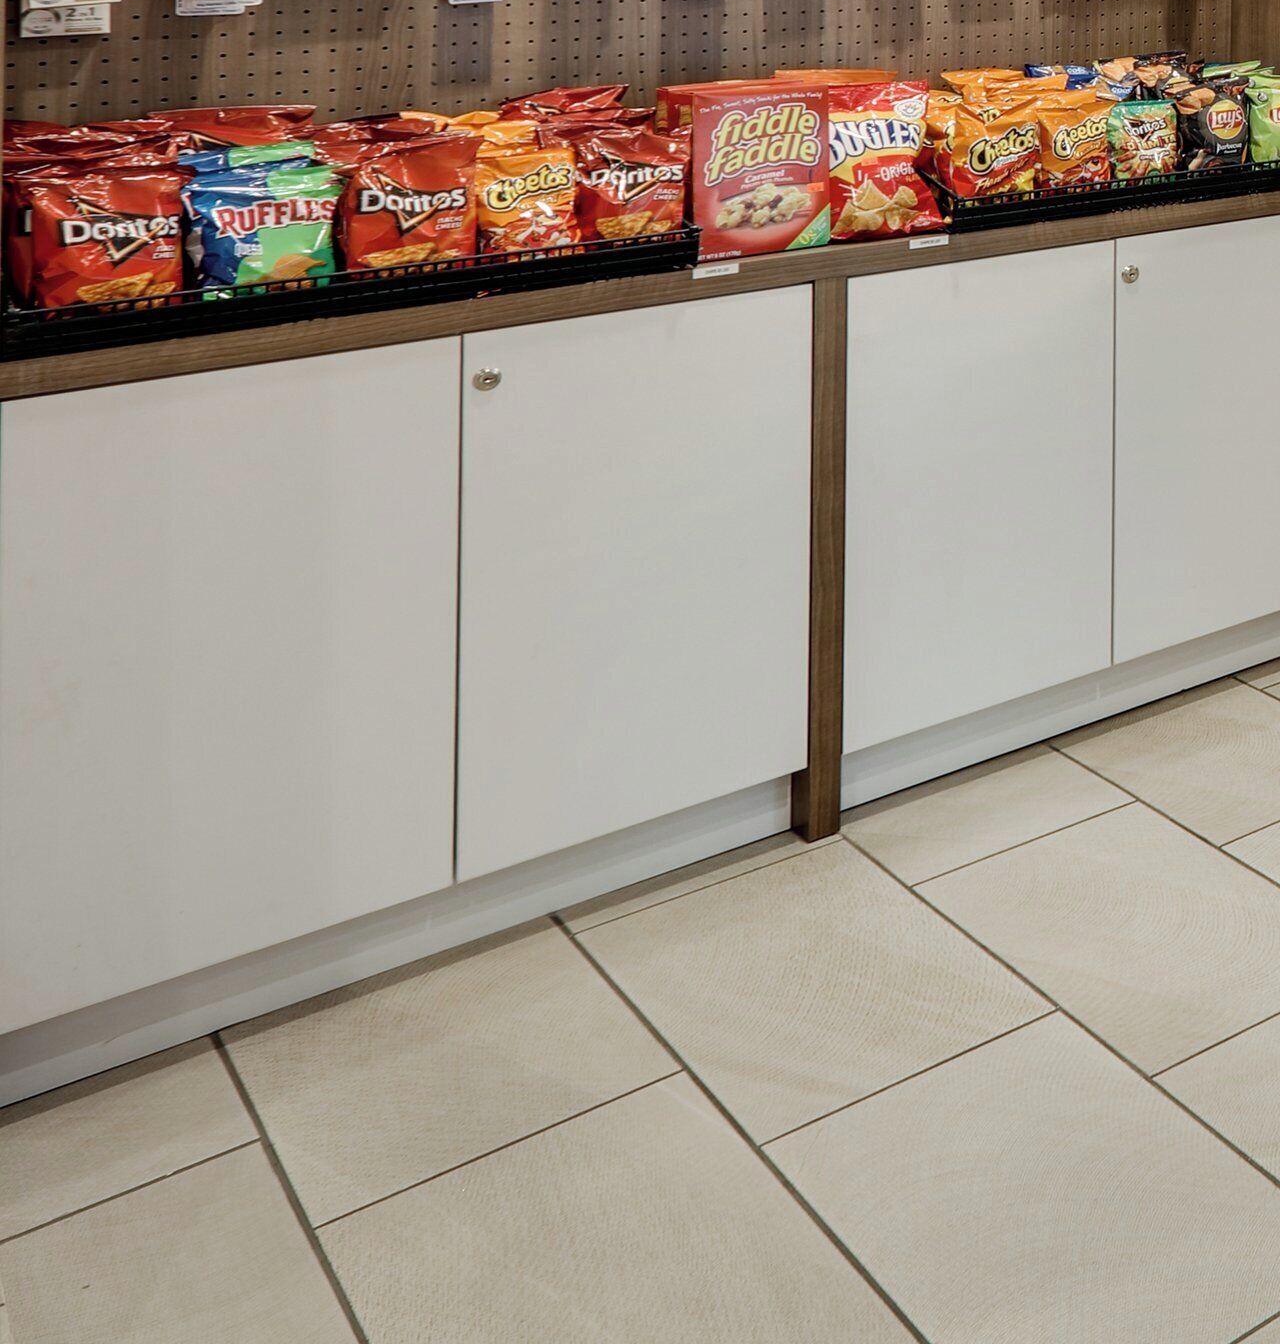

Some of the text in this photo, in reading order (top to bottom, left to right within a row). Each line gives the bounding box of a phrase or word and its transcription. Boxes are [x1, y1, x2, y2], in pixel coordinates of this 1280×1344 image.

[716, 104, 817, 149] fiddle
[1053, 118, 1108, 158] Cheetos
[1124, 118, 1167, 138] Doritos
[1210, 110, 1244, 128] Lay's
[709, 135, 817, 181] faddle
[829, 119, 921, 167] BUGLES
[969, 128, 1037, 173] Cheetos
[487, 164, 572, 210] Cheetos
[591, 165, 683, 187] Doritos
[745, 170, 785, 183] Caramel
[213, 198, 337, 237] RUFFLES
[360, 188, 467, 213] Doritos
[62, 214, 180, 246] Doritos
